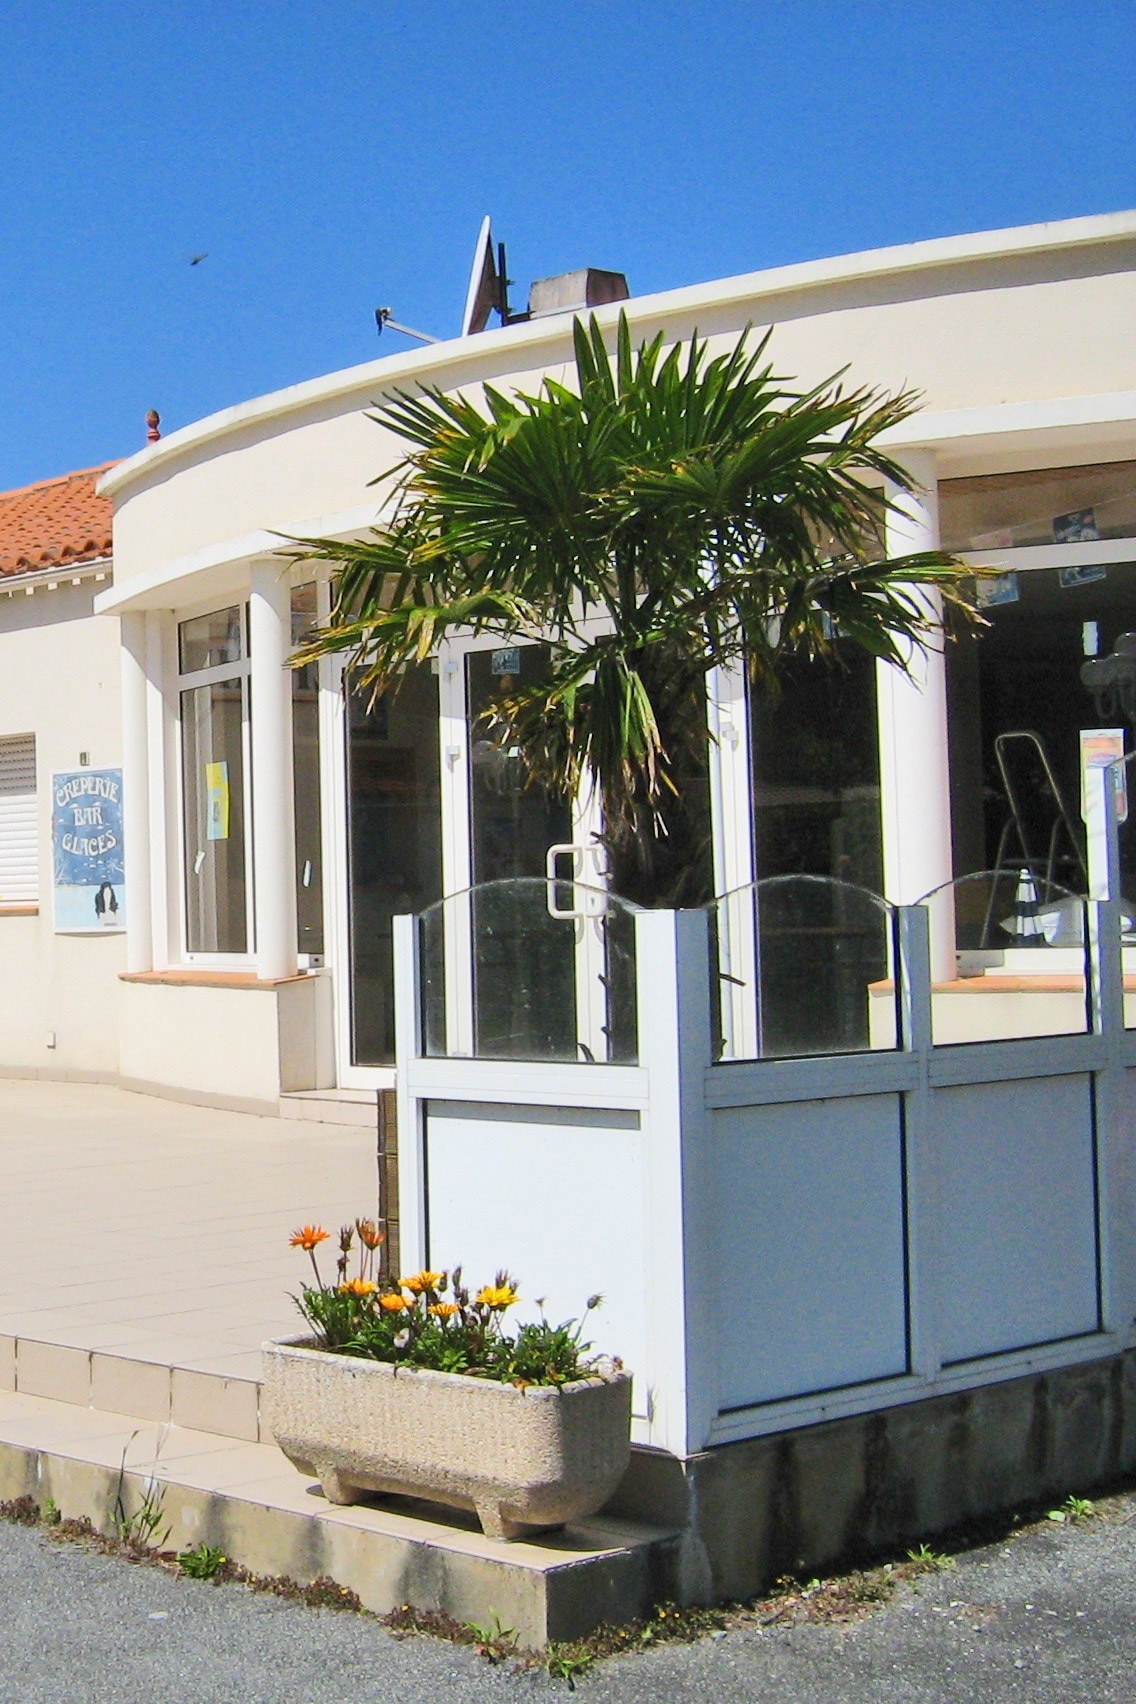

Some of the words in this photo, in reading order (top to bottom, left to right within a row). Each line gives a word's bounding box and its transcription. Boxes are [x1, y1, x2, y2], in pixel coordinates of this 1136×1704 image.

[56, 776, 119, 807] CREPERIE
[73, 806, 103, 826] BAR
[61, 829, 117, 856] GLACES
